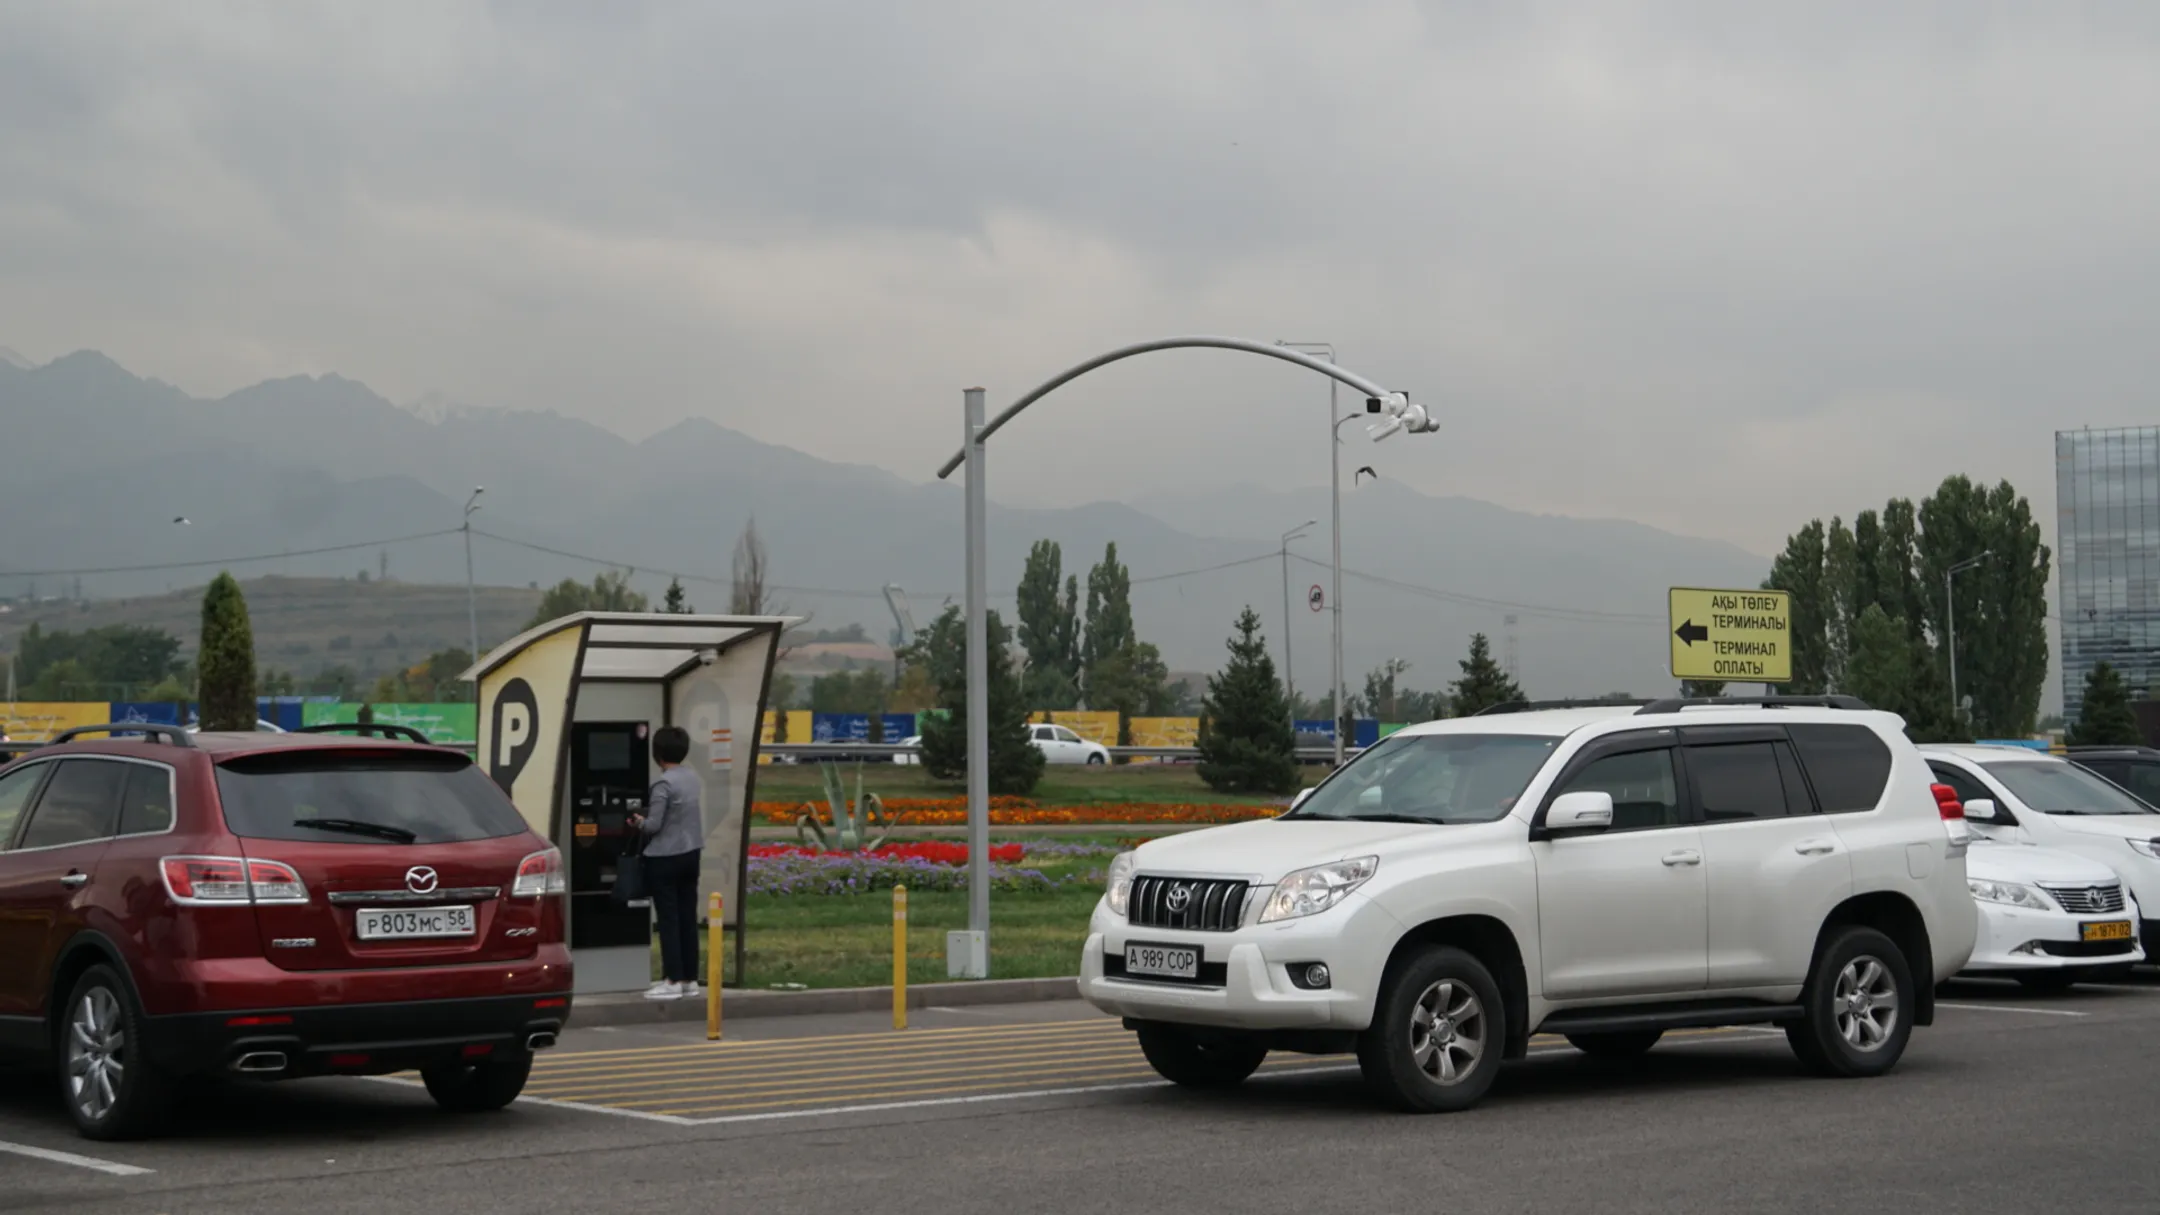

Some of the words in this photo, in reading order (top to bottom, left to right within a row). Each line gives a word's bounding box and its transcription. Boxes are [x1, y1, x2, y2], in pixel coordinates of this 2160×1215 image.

[1712, 595, 1738, 611] АҚЫ
[1741, 596, 1779, 611] ТӨЛЕУ
[1712, 614, 1786, 630] ТЕРМИНАЛЫ
[1713, 641, 1776, 656] ТЕРМИНАЛ
[1714, 660, 1764, 675] ОПЛАТЫ
[499, 702, 530, 766] P
[448, 910, 466, 926] 58
[1142, 949, 1164, 968] 989
